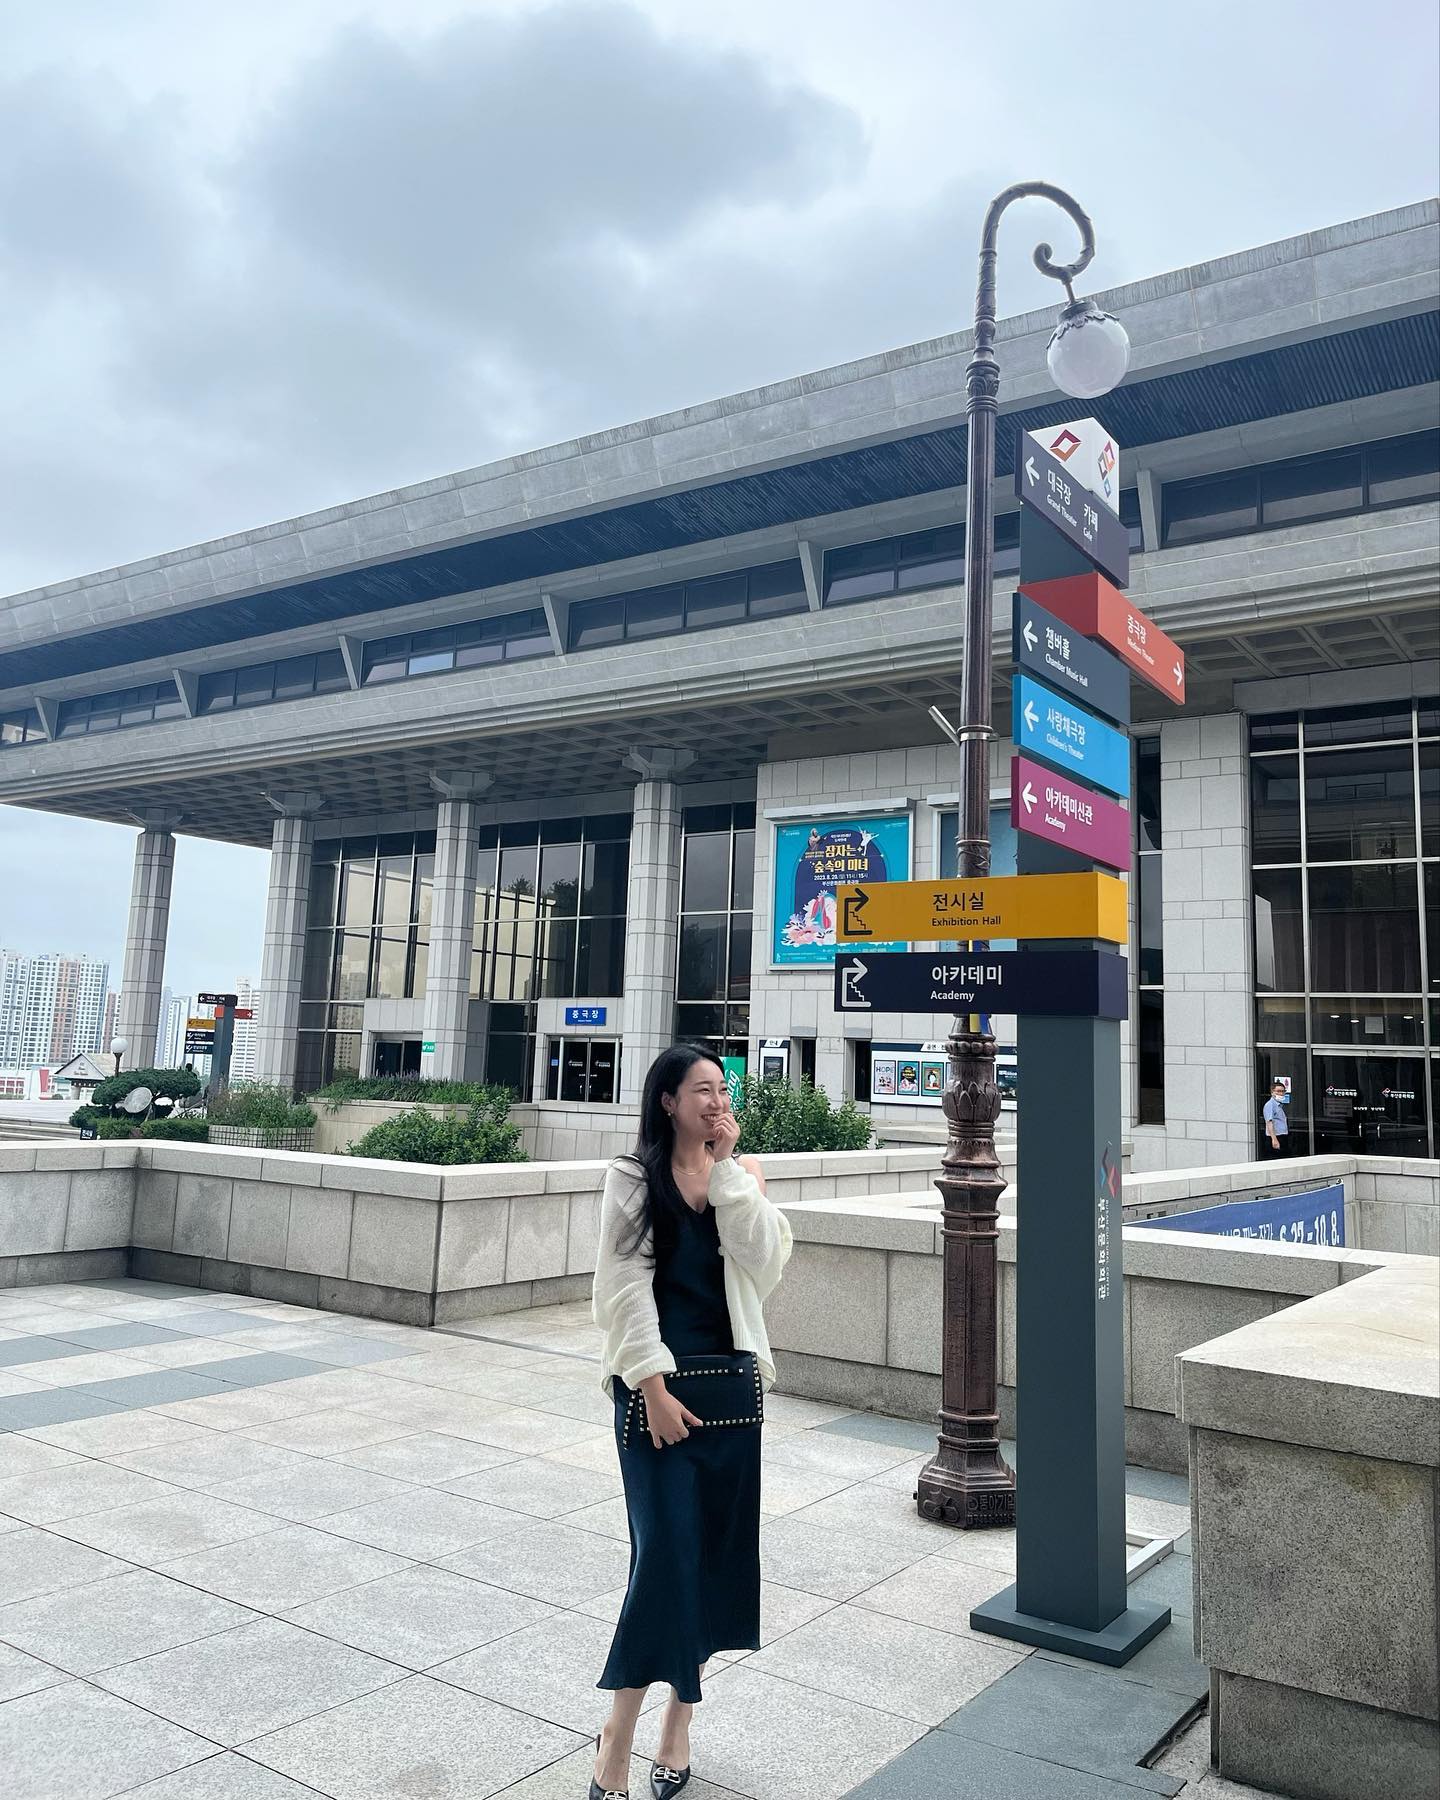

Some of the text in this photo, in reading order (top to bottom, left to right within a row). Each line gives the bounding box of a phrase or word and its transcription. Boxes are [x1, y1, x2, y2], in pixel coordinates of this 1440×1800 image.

[1046, 494, 1061, 513] Grand
[1047, 469, 1098, 532] 대극장 카페
[1127, 614, 1146, 645] 중극장
[1045, 626, 1071, 660] 챔버홀
[1045, 653, 1088, 687] Chamber Music Hall
[1046, 707, 1086, 745] 사랑채극장
[1045, 787, 1093, 826] 아카데미신관
[1044, 813, 1066, 833] Academy
[825, 844, 857, 858] 잠자는
[814, 858, 869, 873] 숲속의 미녀
[932, 891, 985, 912] 전시실
[931, 915, 1001, 927] Exhibition Hall
[931, 964, 1003, 986] 아카데미
[930, 990, 975, 1003] Academy
[572, 1010, 599, 1019] 중극장
[1097, 1197, 1107, 1300] 부산문화회관
